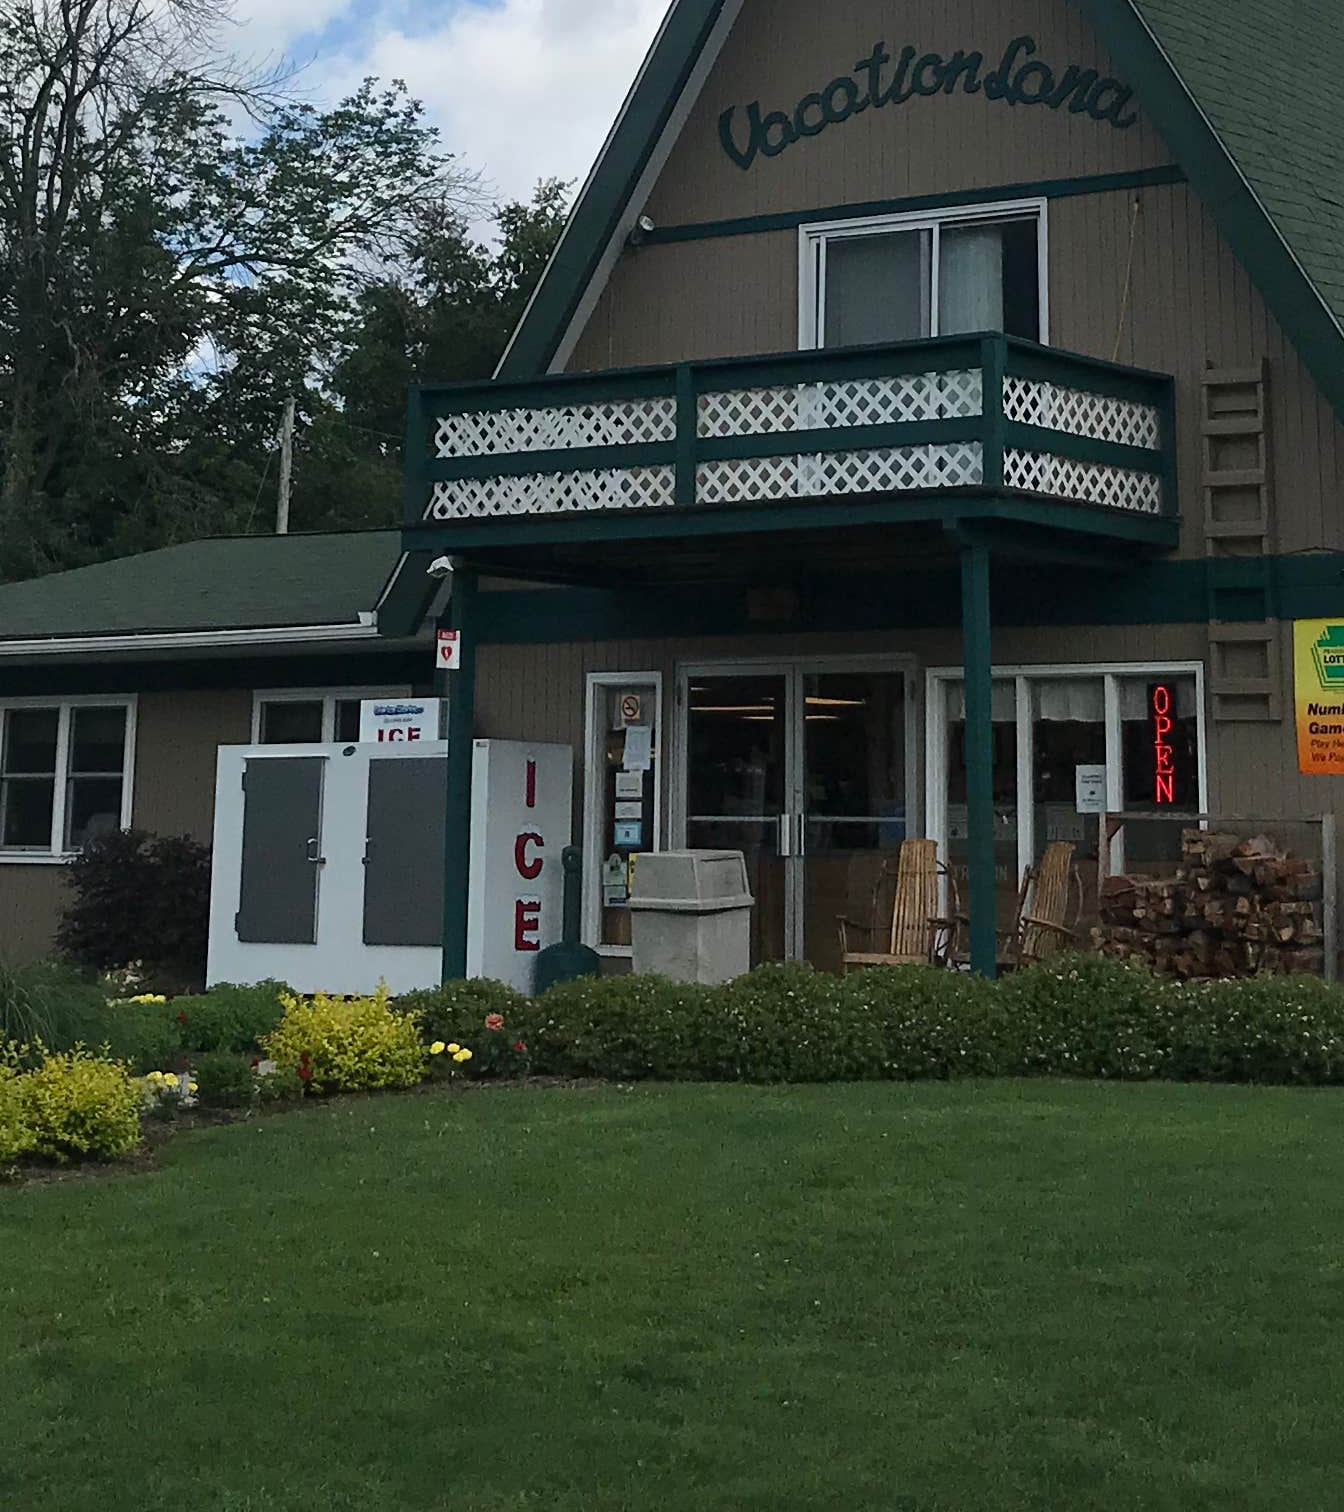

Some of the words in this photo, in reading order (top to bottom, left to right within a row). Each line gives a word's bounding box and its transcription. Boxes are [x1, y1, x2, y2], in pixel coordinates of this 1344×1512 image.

[377, 726, 422, 743] ICE
[1151, 685, 1176, 804] OPEN
[1311, 751, 1327, 762] We
[513, 757, 545, 952] ICE
